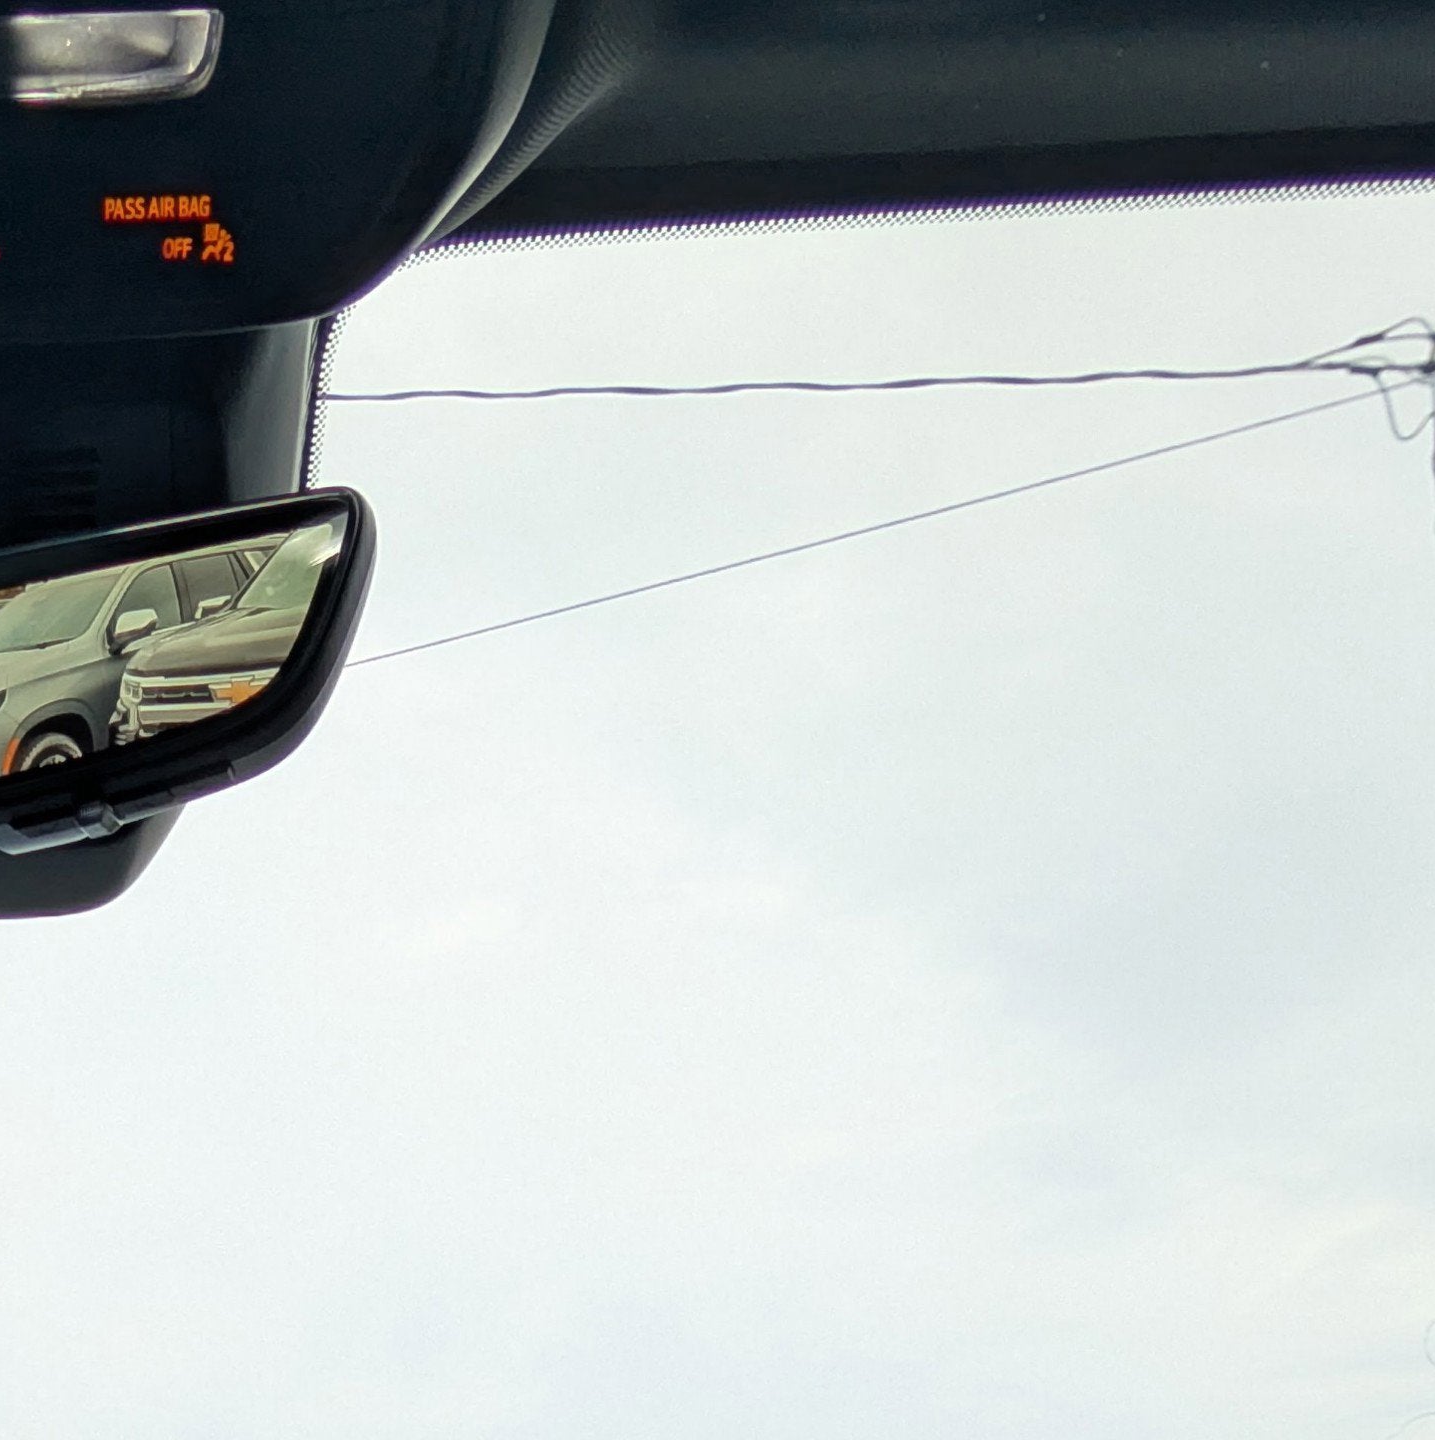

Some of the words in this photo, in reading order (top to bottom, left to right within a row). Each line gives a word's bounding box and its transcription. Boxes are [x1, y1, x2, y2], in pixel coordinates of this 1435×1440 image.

[105, 197, 145, 220] PASS
[148, 196, 175, 219] AIR
[178, 195, 211, 217] BAG
[162, 237, 193, 260] OFF
